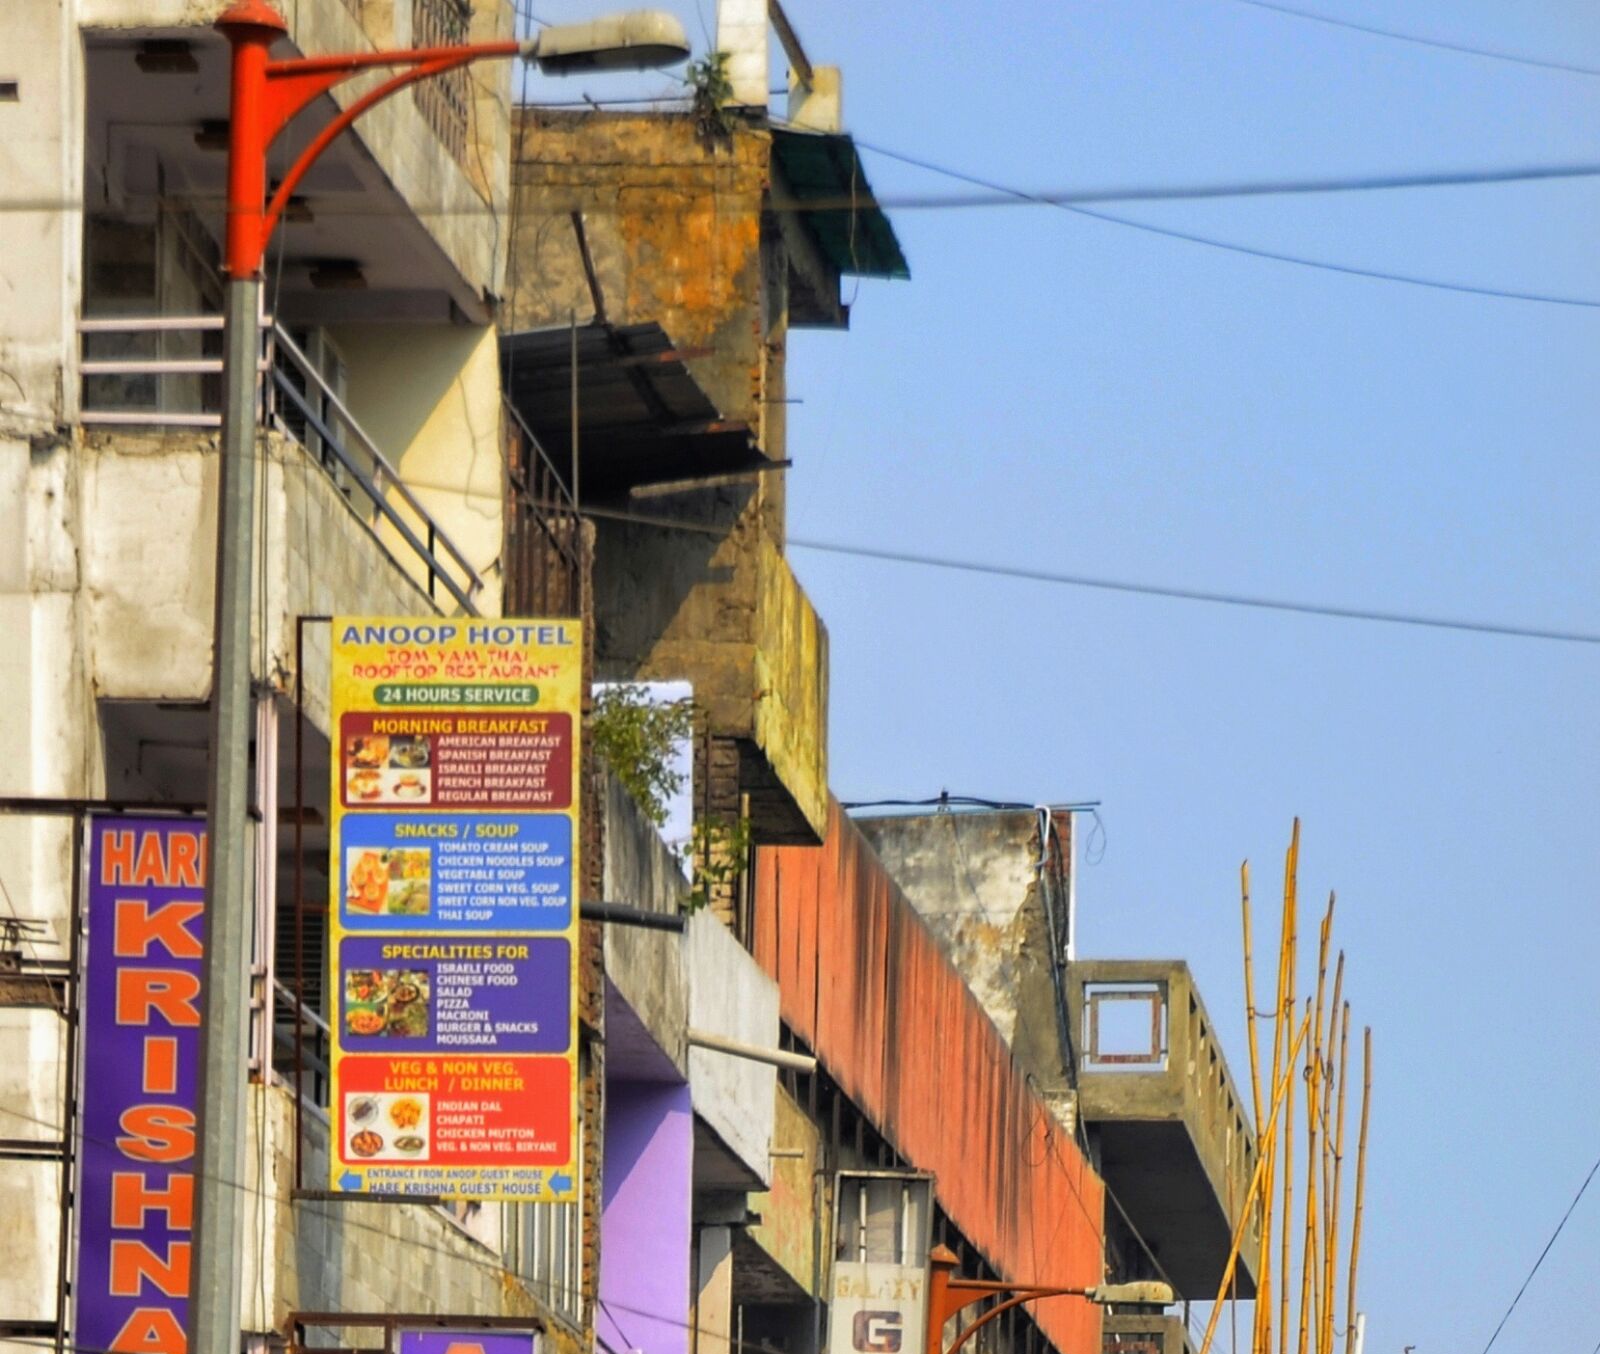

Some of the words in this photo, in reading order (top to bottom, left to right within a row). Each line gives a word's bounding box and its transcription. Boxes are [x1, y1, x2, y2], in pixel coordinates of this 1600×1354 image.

[342, 626, 457, 645] ANOOP
[469, 626, 573, 645] HOTEL
[353, 665, 437, 679] ROOFTOP
[445, 665, 560, 679] RESTAURANT
[383, 688, 401, 701] 24
[406, 688, 460, 701] HOURS
[465, 688, 531, 701] SERVICE
[373, 719, 452, 734] MORNING
[457, 719, 549, 734] BREAKFAST
[438, 736, 496, 747] AMERICAN
[499, 736, 561, 747] BREAKFAST
[395, 824, 458, 838] SNACKS
[475, 824, 519, 838] SOUP
[100, 828, 208, 887] HAR
[382, 945, 492, 959] SPECIALITIES
[496, 945, 528, 959] FOR
[437, 987, 472, 997] SALAD
[437, 999, 469, 1009] PIZZA
[437, 1011, 489, 1021] MACRONI
[437, 1034, 497, 1044] MOUSSAKA
[390, 1062, 421, 1074] VEG
[426, 1062, 437, 1074] &
[443, 1062, 478, 1074] NON
[482, 1062, 518, 1074] VEG.
[385, 1078, 438, 1091] LUNCH
[461, 1078, 524, 1091] DINNER
[436, 1102, 477, 1112] INDIAN
[481, 1102, 502, 1112] DAL
[436, 1115, 484, 1125] CHAPATI
[436, 1129, 486, 1139] CHICKEN
[488, 1129, 534, 1139] MUTTON
[369, 1182, 400, 1194] HARE
[404, 1182, 455, 1194] KRISHNA
[460, 1182, 497, 1194] GUEST
[502, 1182, 541, 1194] HOUSE
